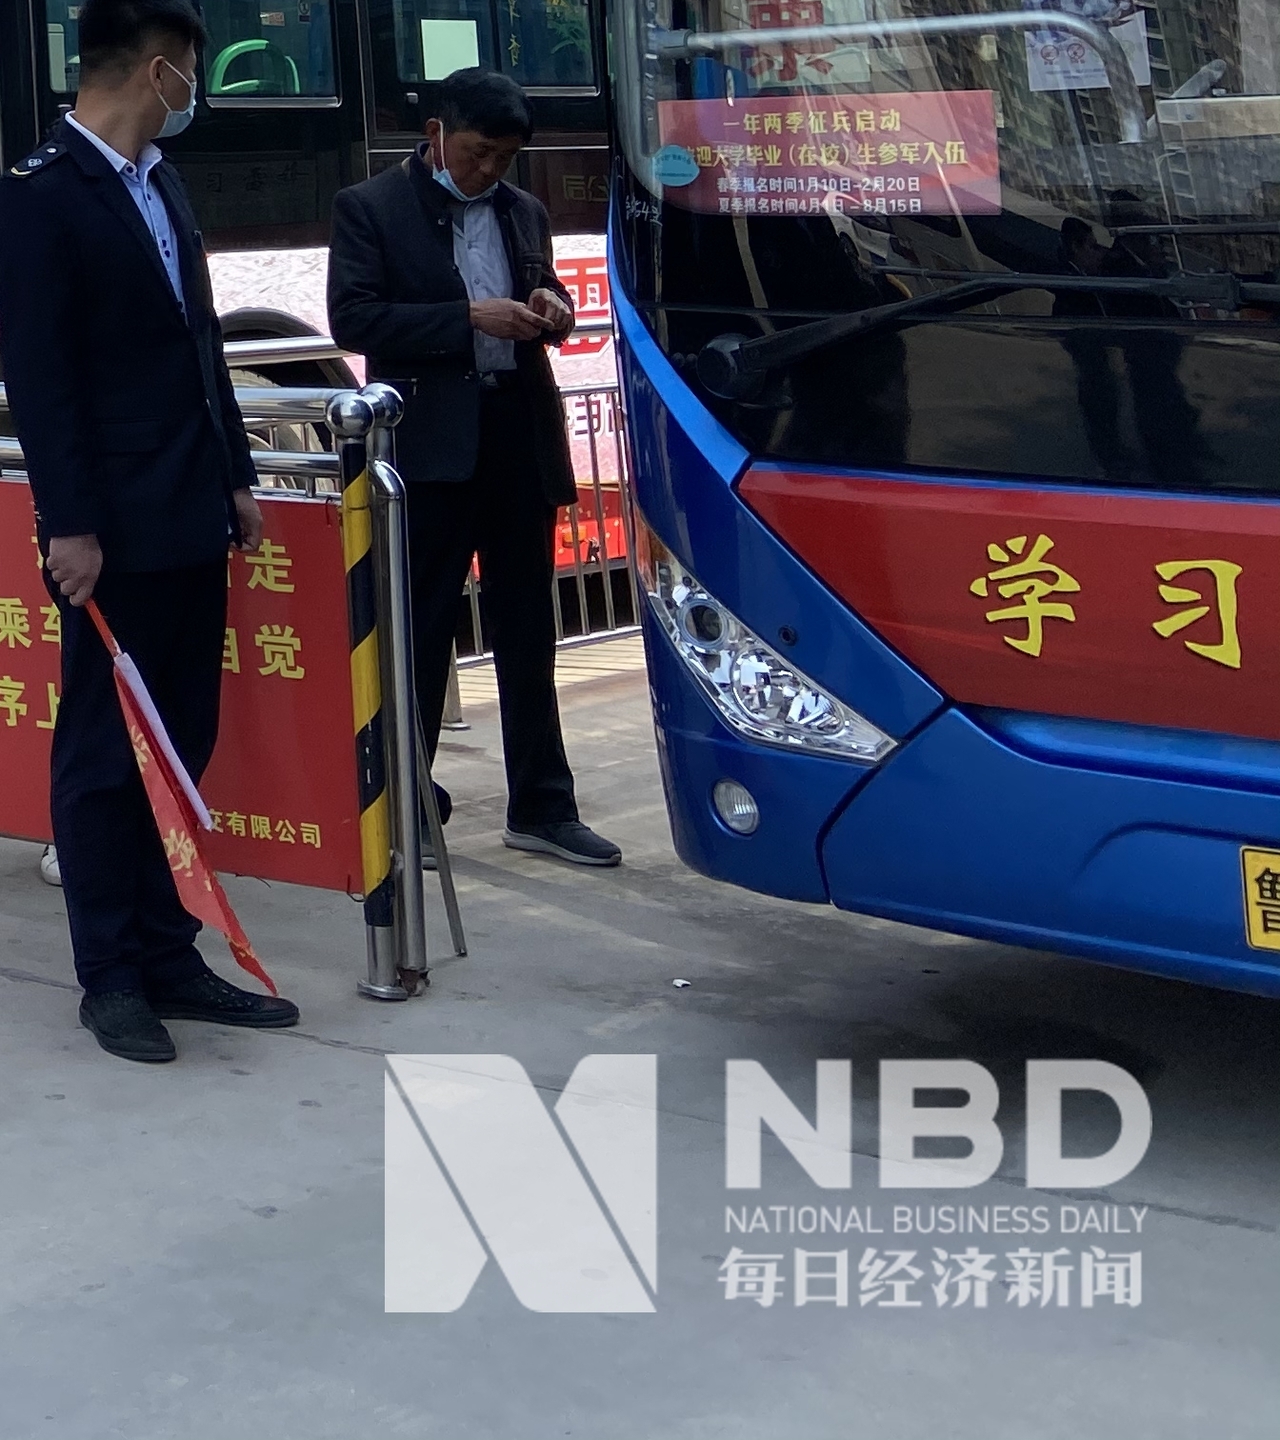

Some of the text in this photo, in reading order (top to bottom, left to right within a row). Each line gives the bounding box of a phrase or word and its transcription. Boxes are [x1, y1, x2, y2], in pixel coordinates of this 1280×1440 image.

[722, 108, 902, 135] 一年两季征兵启动
[968, 534, 1244, 670] 学习
